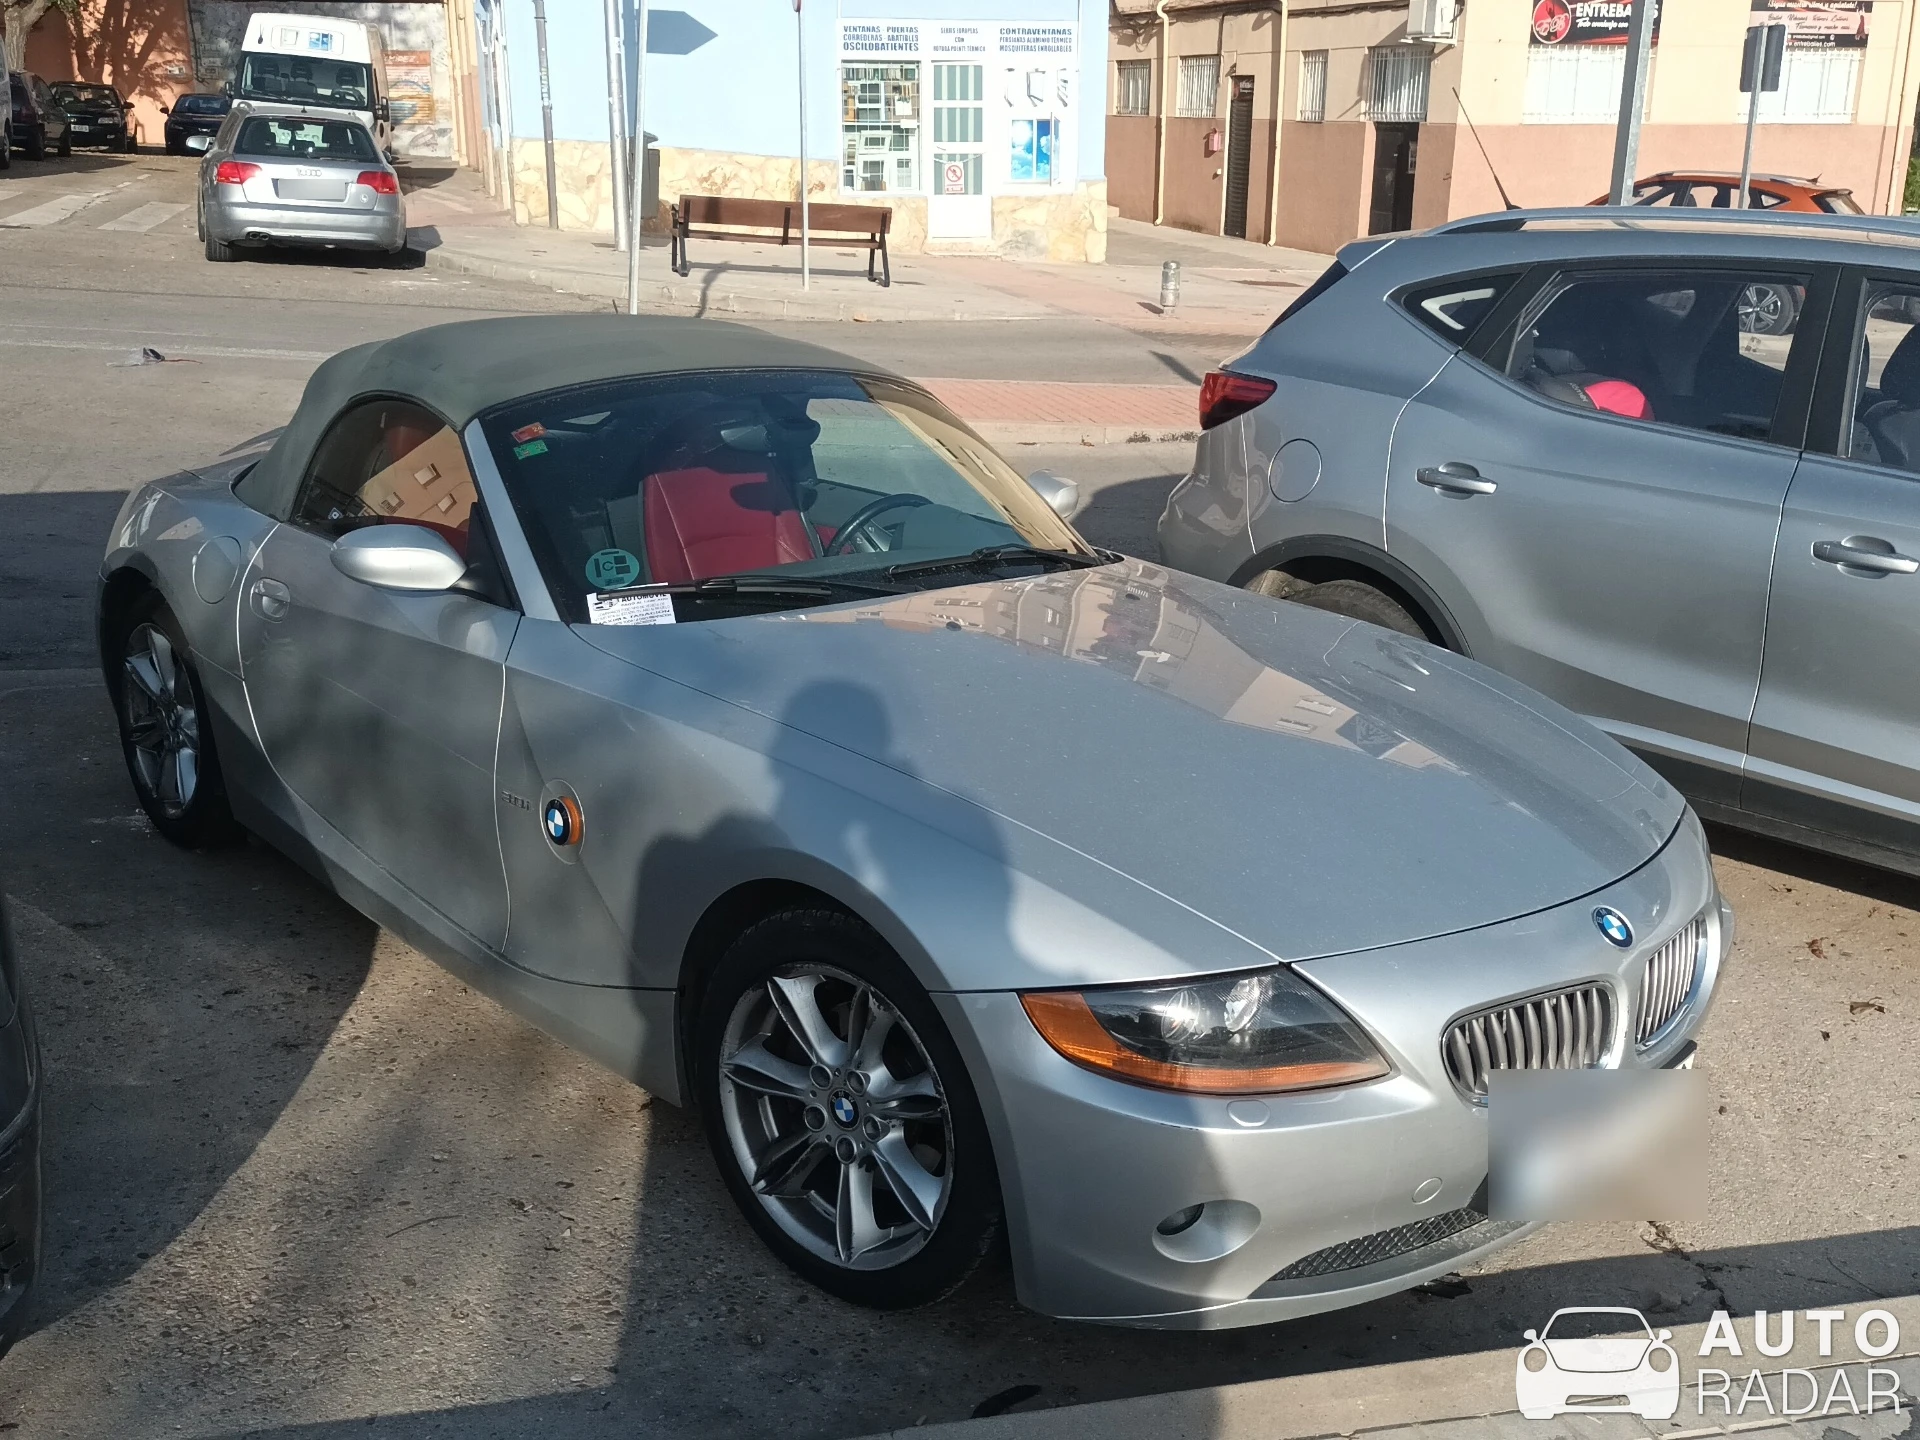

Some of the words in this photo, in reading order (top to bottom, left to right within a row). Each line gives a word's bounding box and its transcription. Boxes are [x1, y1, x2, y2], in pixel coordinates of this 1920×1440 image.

[843, 25, 880, 33] VENTANAS
[843, 33, 882, 41] CORREDERAS
[887, 34, 919, 42] ABATIBLES
[843, 41, 919, 51] OSCILOBATIENTES
[999, 44, 1037, 52] MOSQUITERAS
